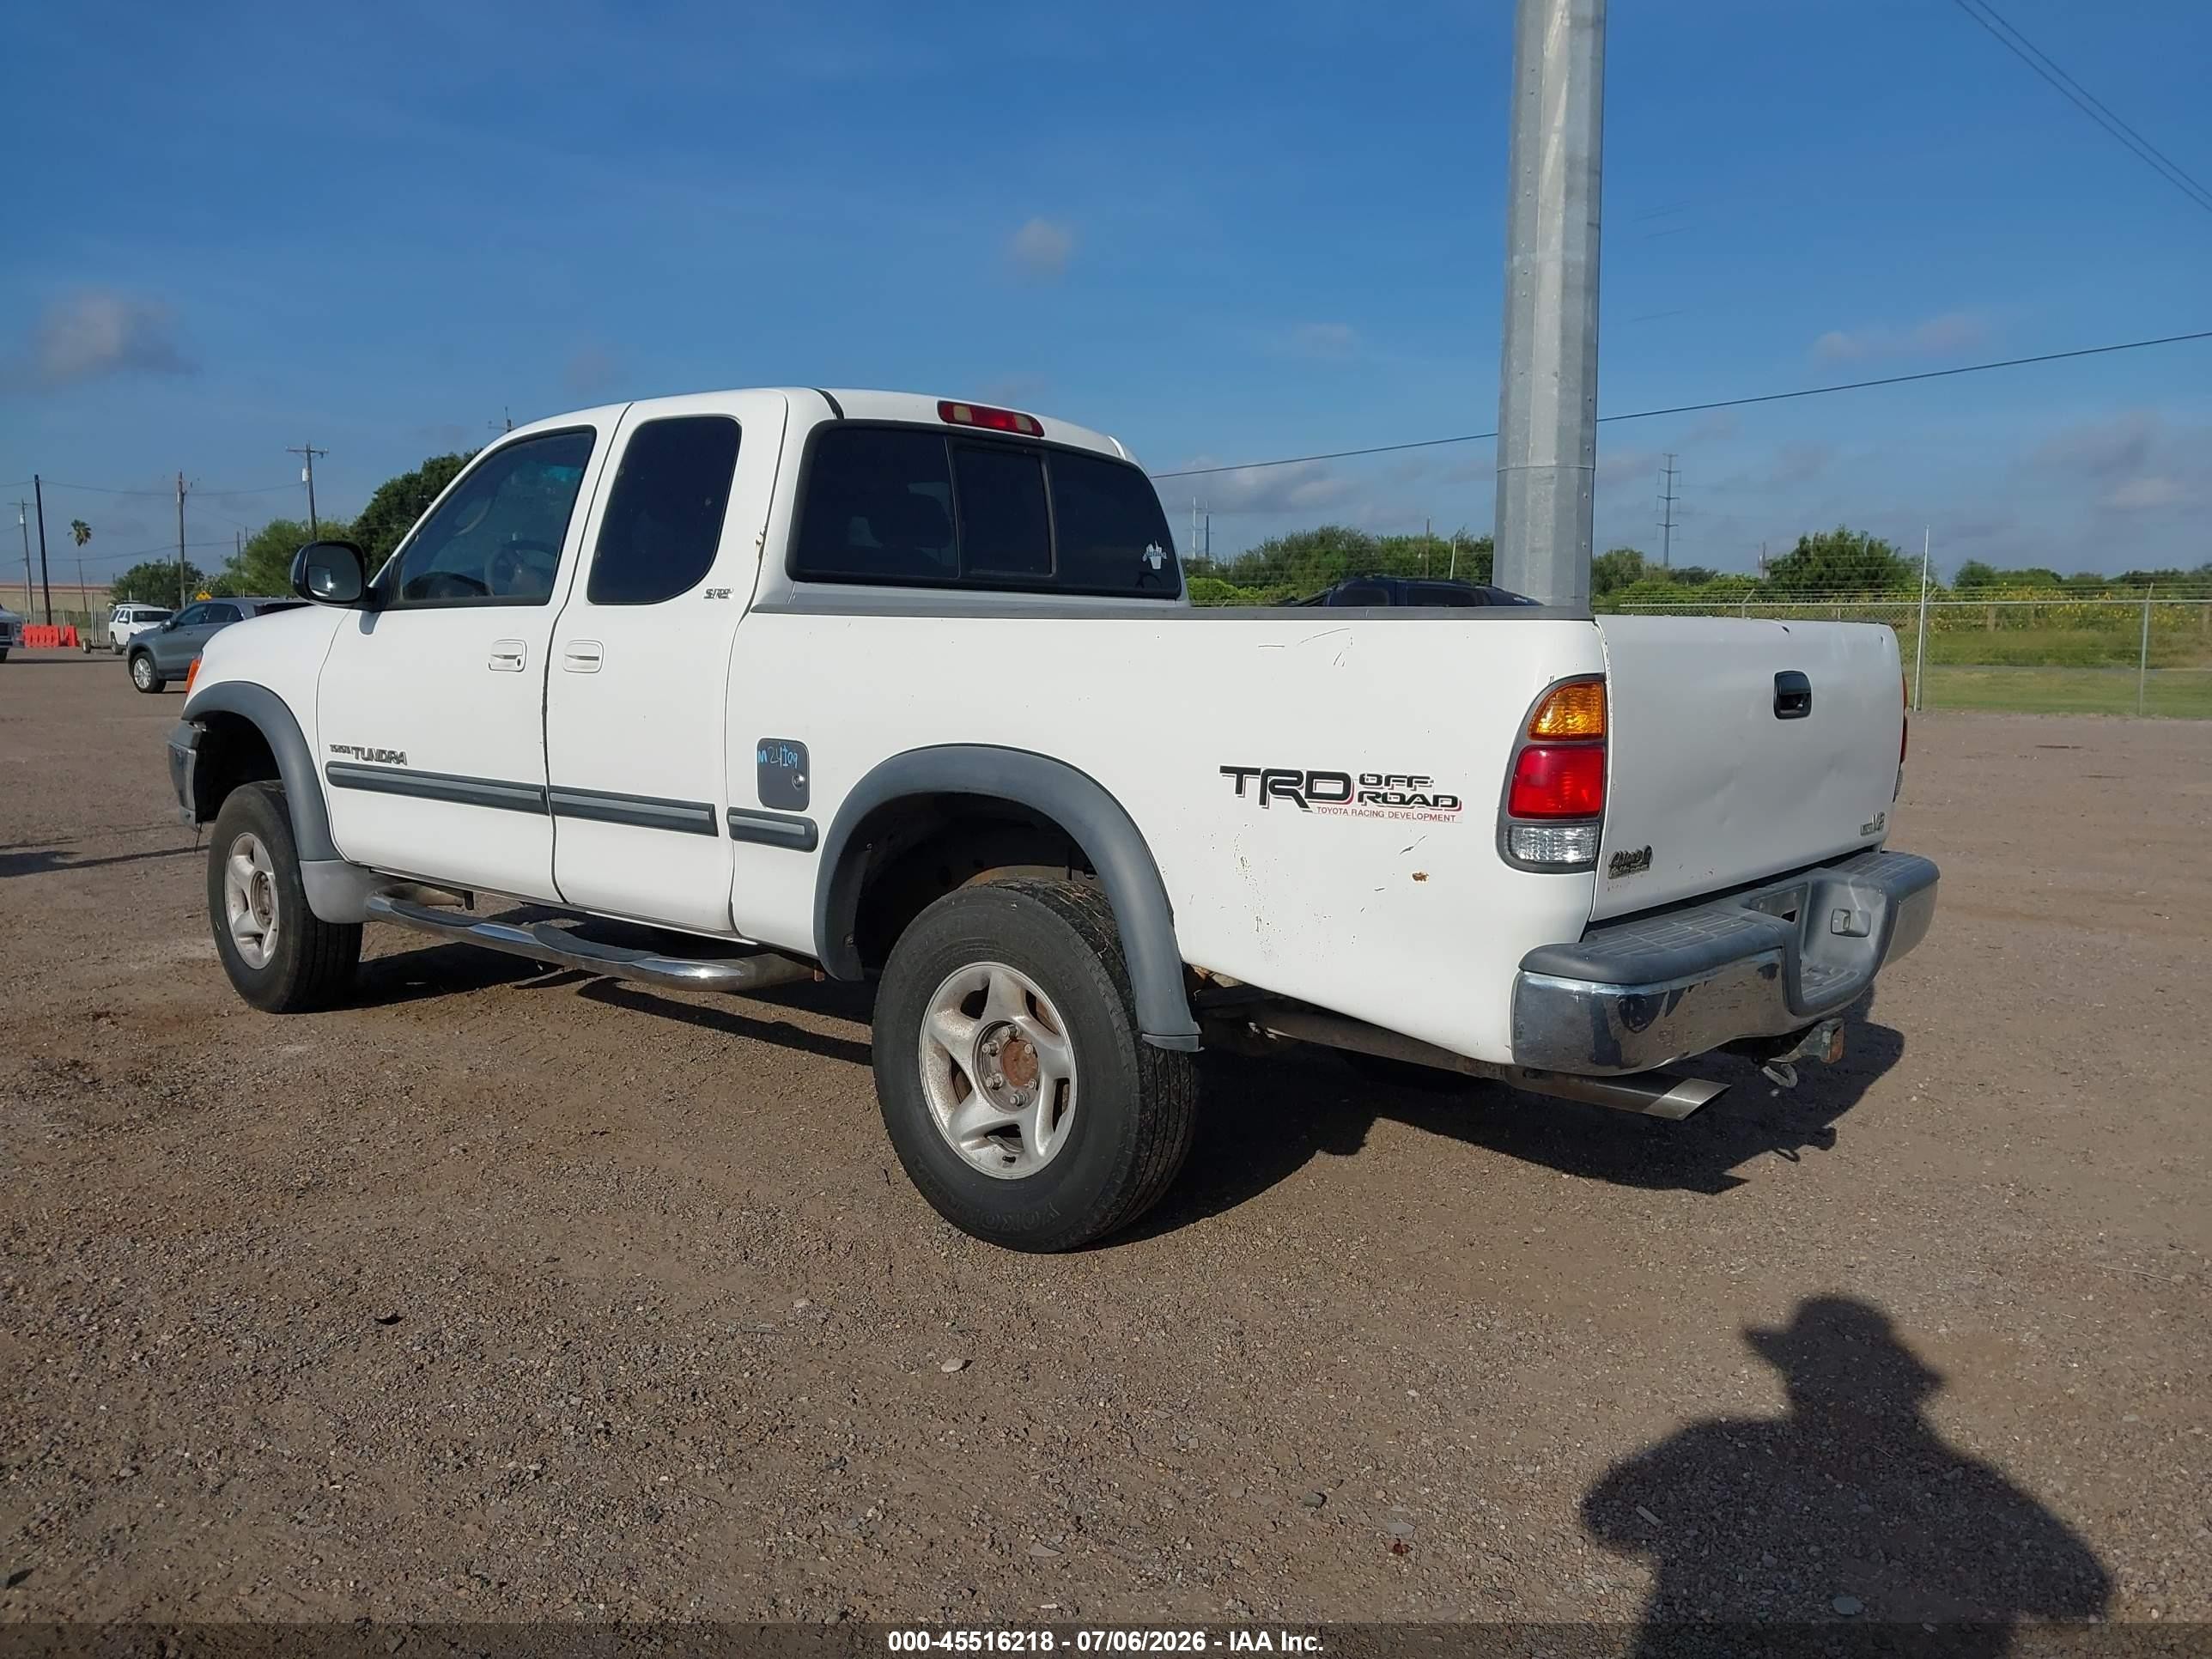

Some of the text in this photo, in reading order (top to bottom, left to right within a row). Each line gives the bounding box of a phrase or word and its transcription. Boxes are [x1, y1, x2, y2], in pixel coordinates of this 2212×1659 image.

[351, 746, 408, 766] TUNDRA
[1219, 765, 1353, 811] TRD
[1358, 773, 1433, 790] OFF
[1357, 790, 1462, 811] ROAD
[1317, 806, 1456, 823] TOYOTA RACING DEVELOPMENT
